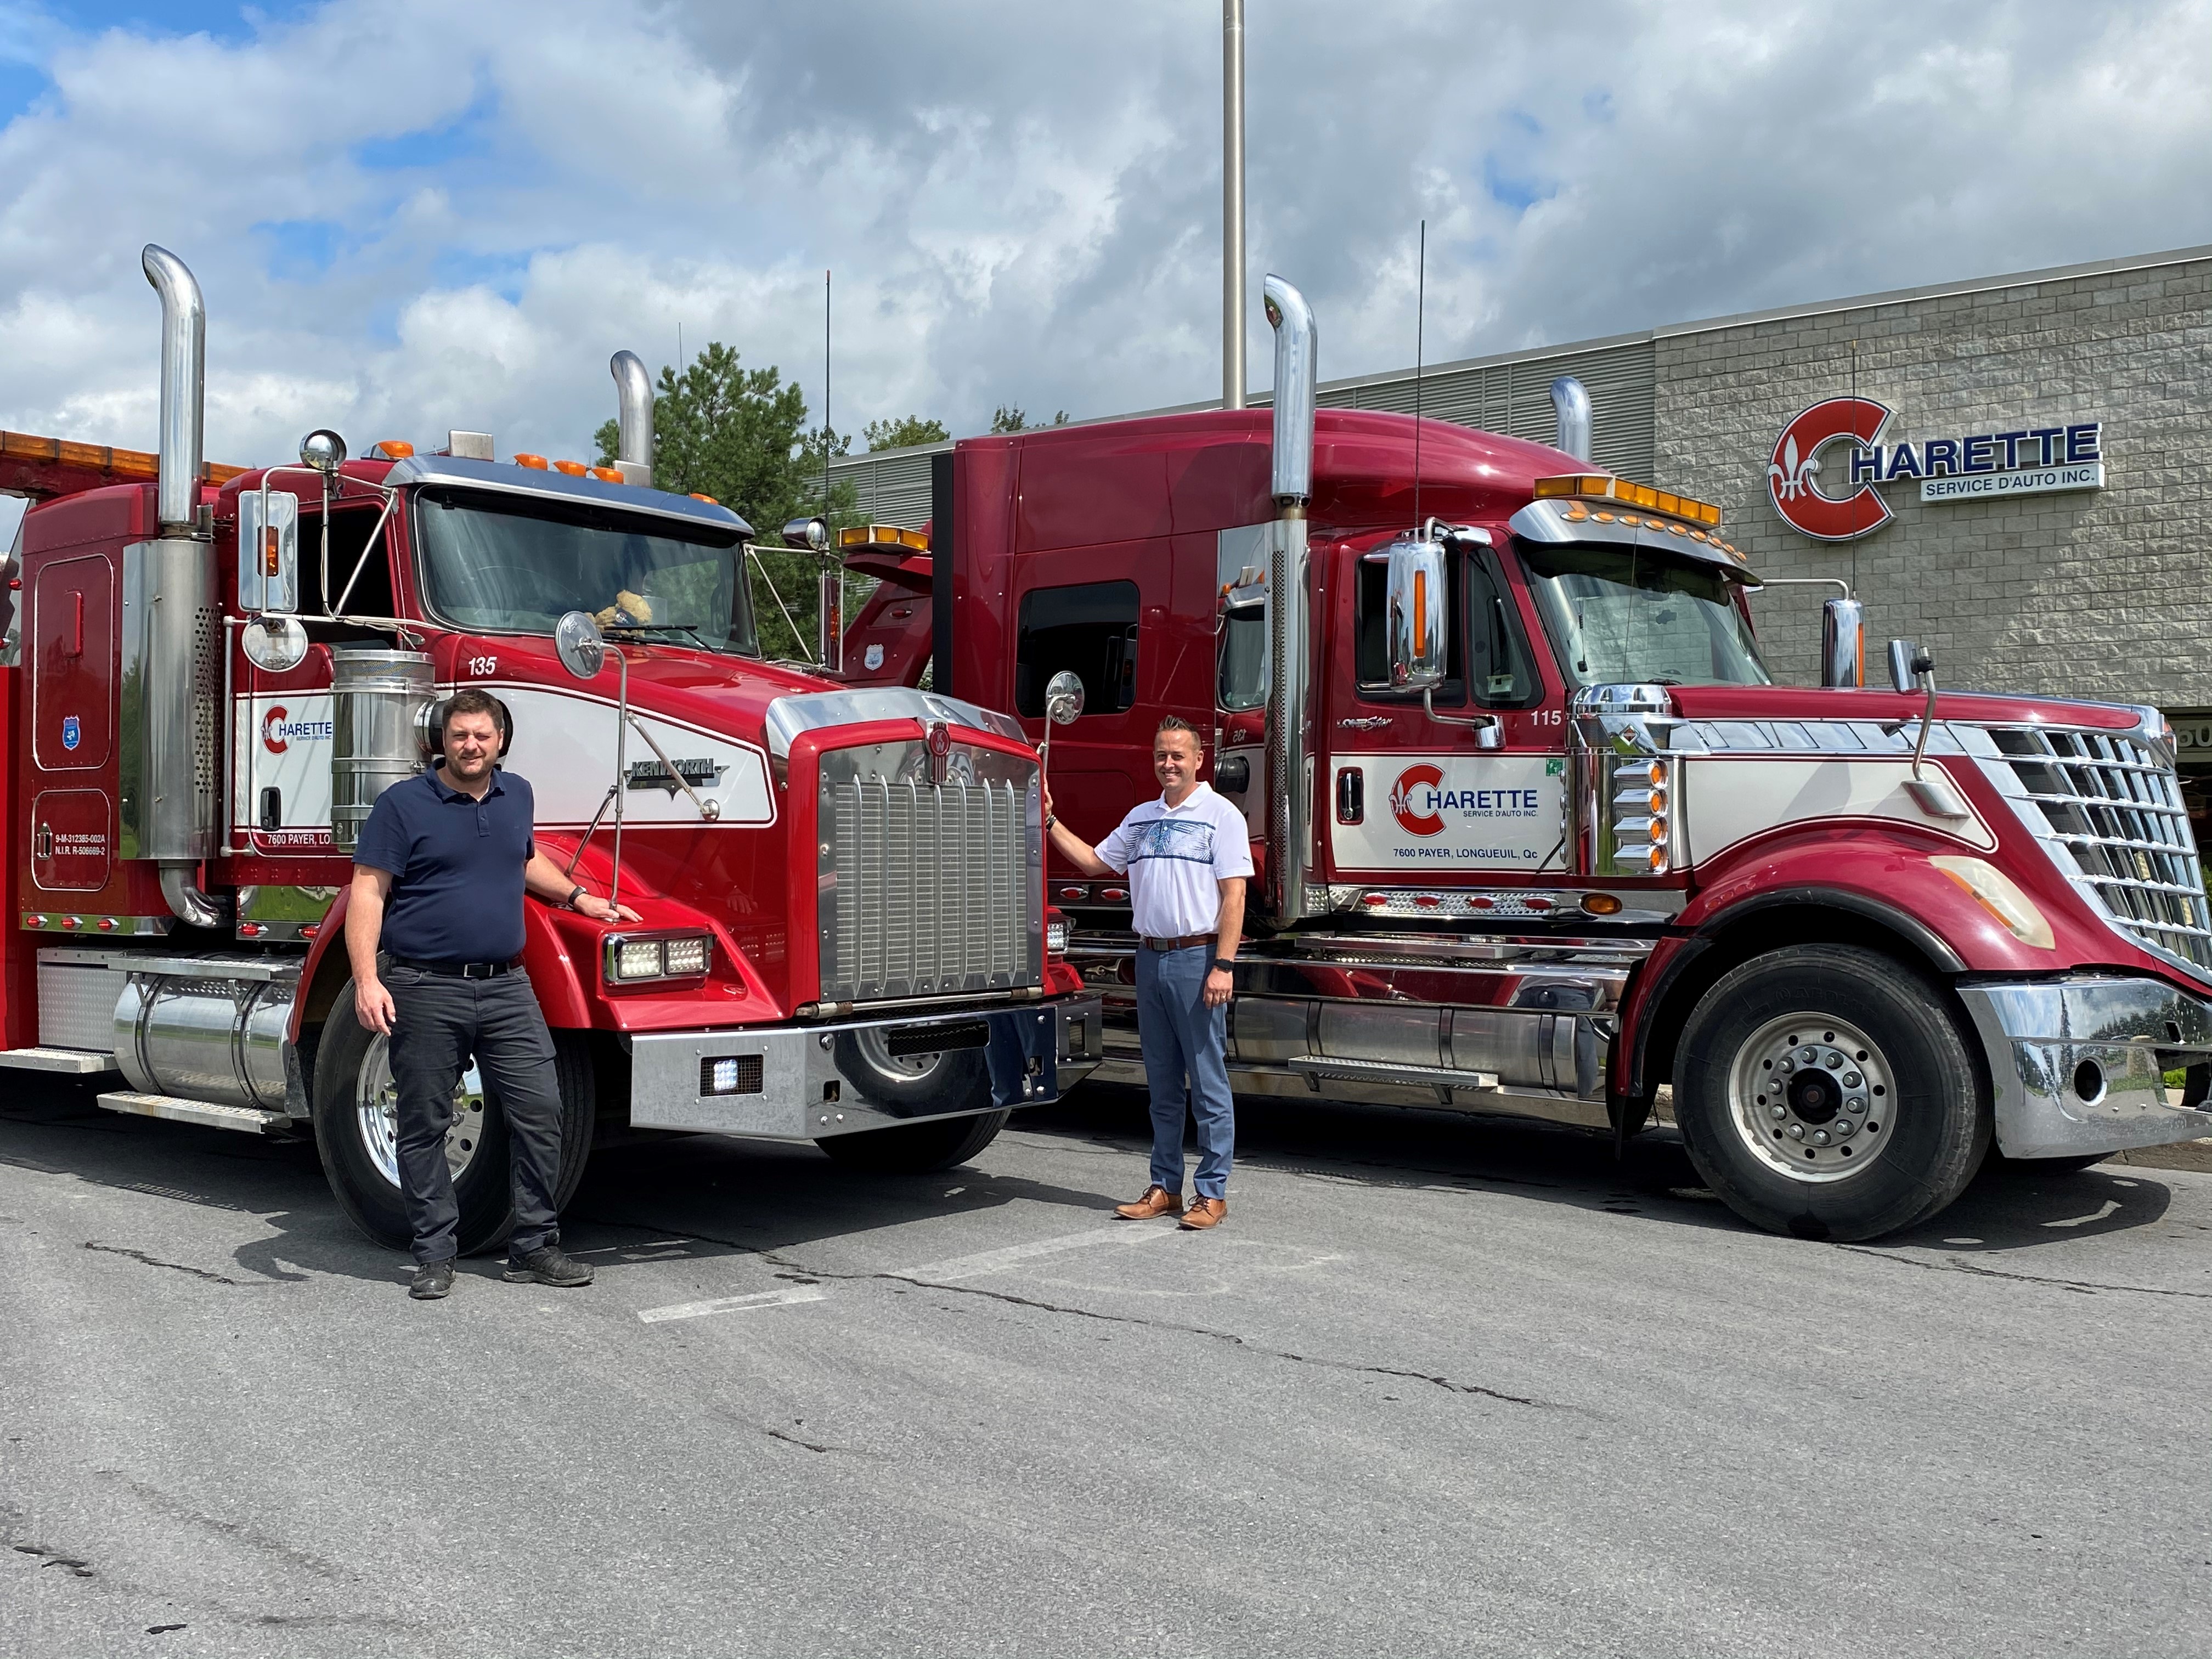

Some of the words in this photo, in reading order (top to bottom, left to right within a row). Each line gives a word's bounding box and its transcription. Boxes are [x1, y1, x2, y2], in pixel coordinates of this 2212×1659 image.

[1768, 396, 2102, 541] CHARETTE
[1926, 478, 1993, 496] SERVICE
[1999, 473, 2057, 490] D'AUTO
[2062, 469, 2095, 483] INC.
[469, 656, 498, 675] 135
[1531, 710, 1562, 725] 115
[1389, 762, 1538, 838] CHARETTE
[267, 834, 286, 844] 7600
[288, 834, 317, 847] PAYER,
[319, 834, 330, 844] LO
[1393, 848, 1415, 857] 7600
[1418, 848, 1454, 859] PAYER,
[1457, 848, 1520, 860] LONGUEUIL,
[1523, 849, 1538, 859] Qc
